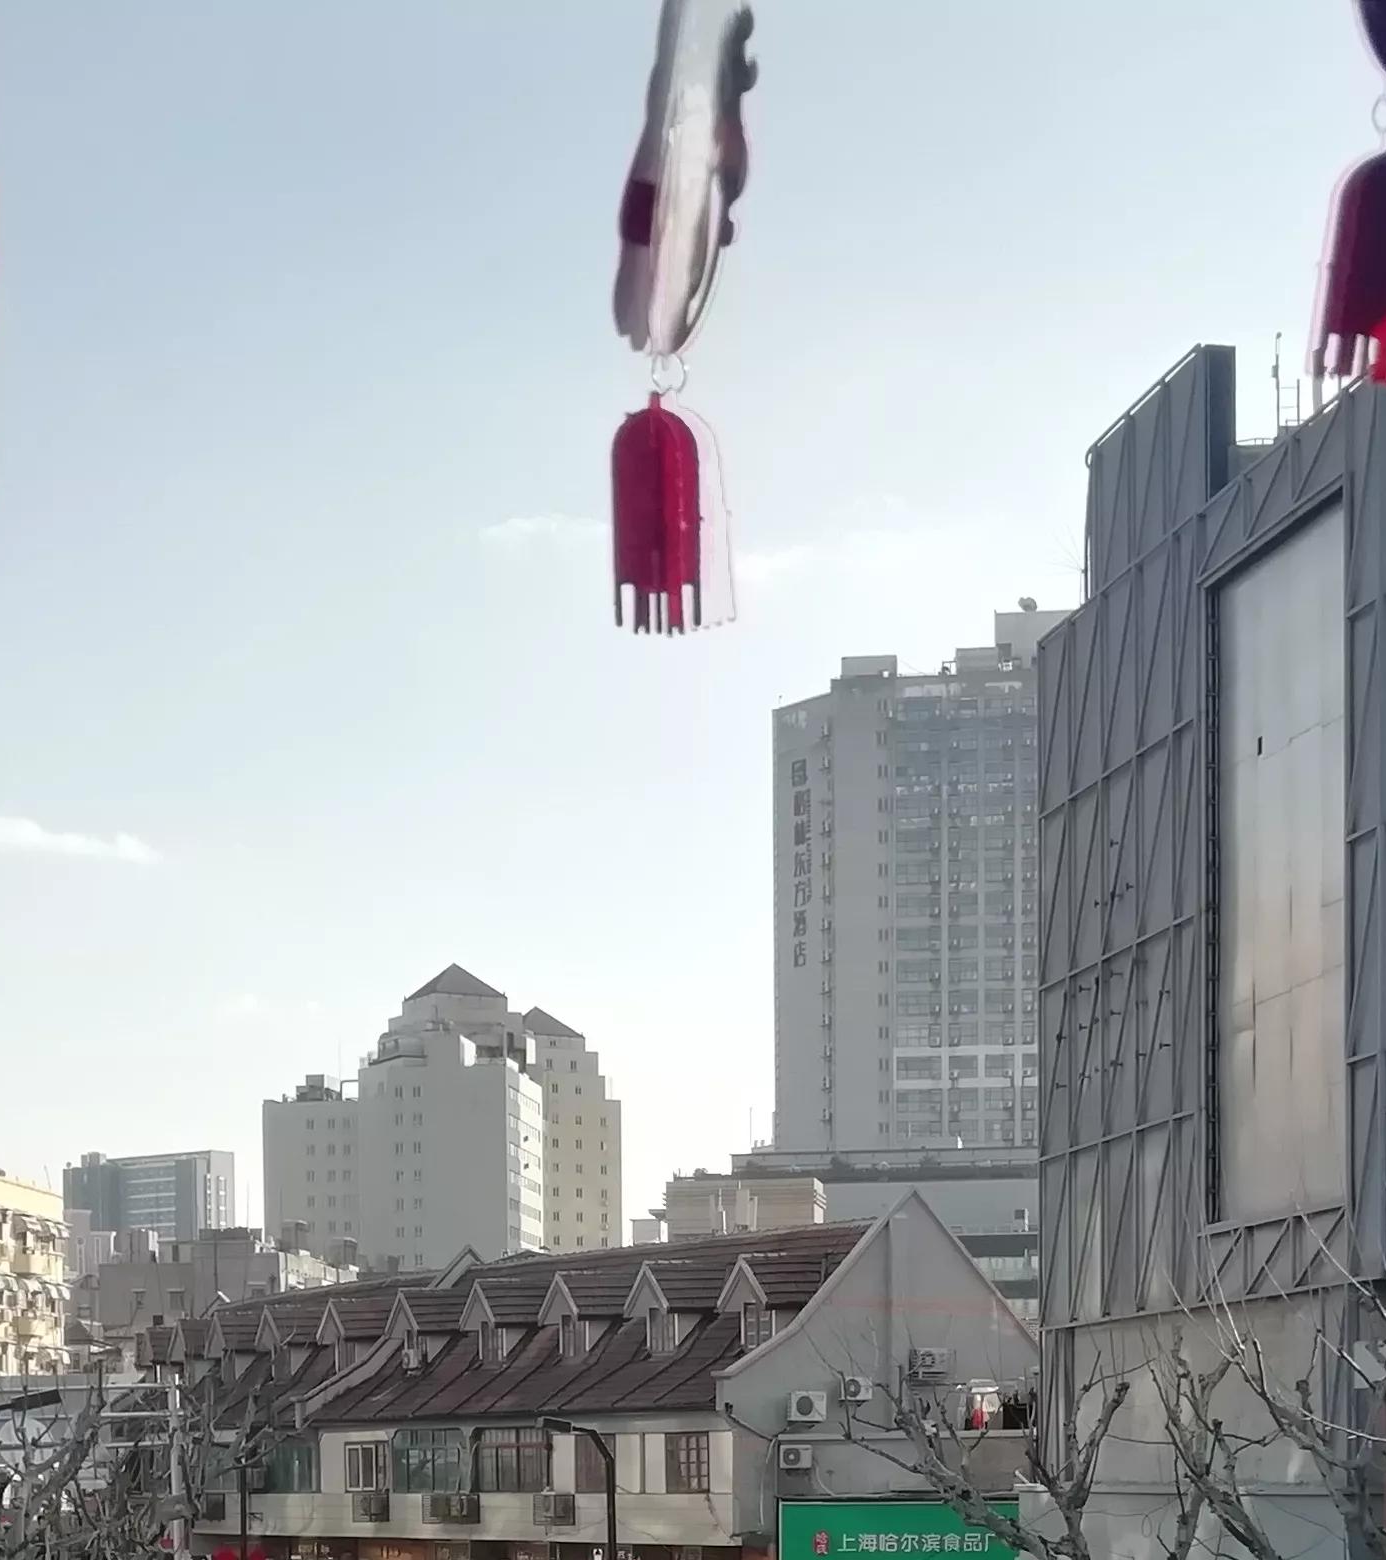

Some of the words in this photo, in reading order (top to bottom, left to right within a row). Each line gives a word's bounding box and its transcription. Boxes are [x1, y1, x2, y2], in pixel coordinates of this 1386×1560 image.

[837, 1532, 997, 1553] 上海哈尔滨食品厂
